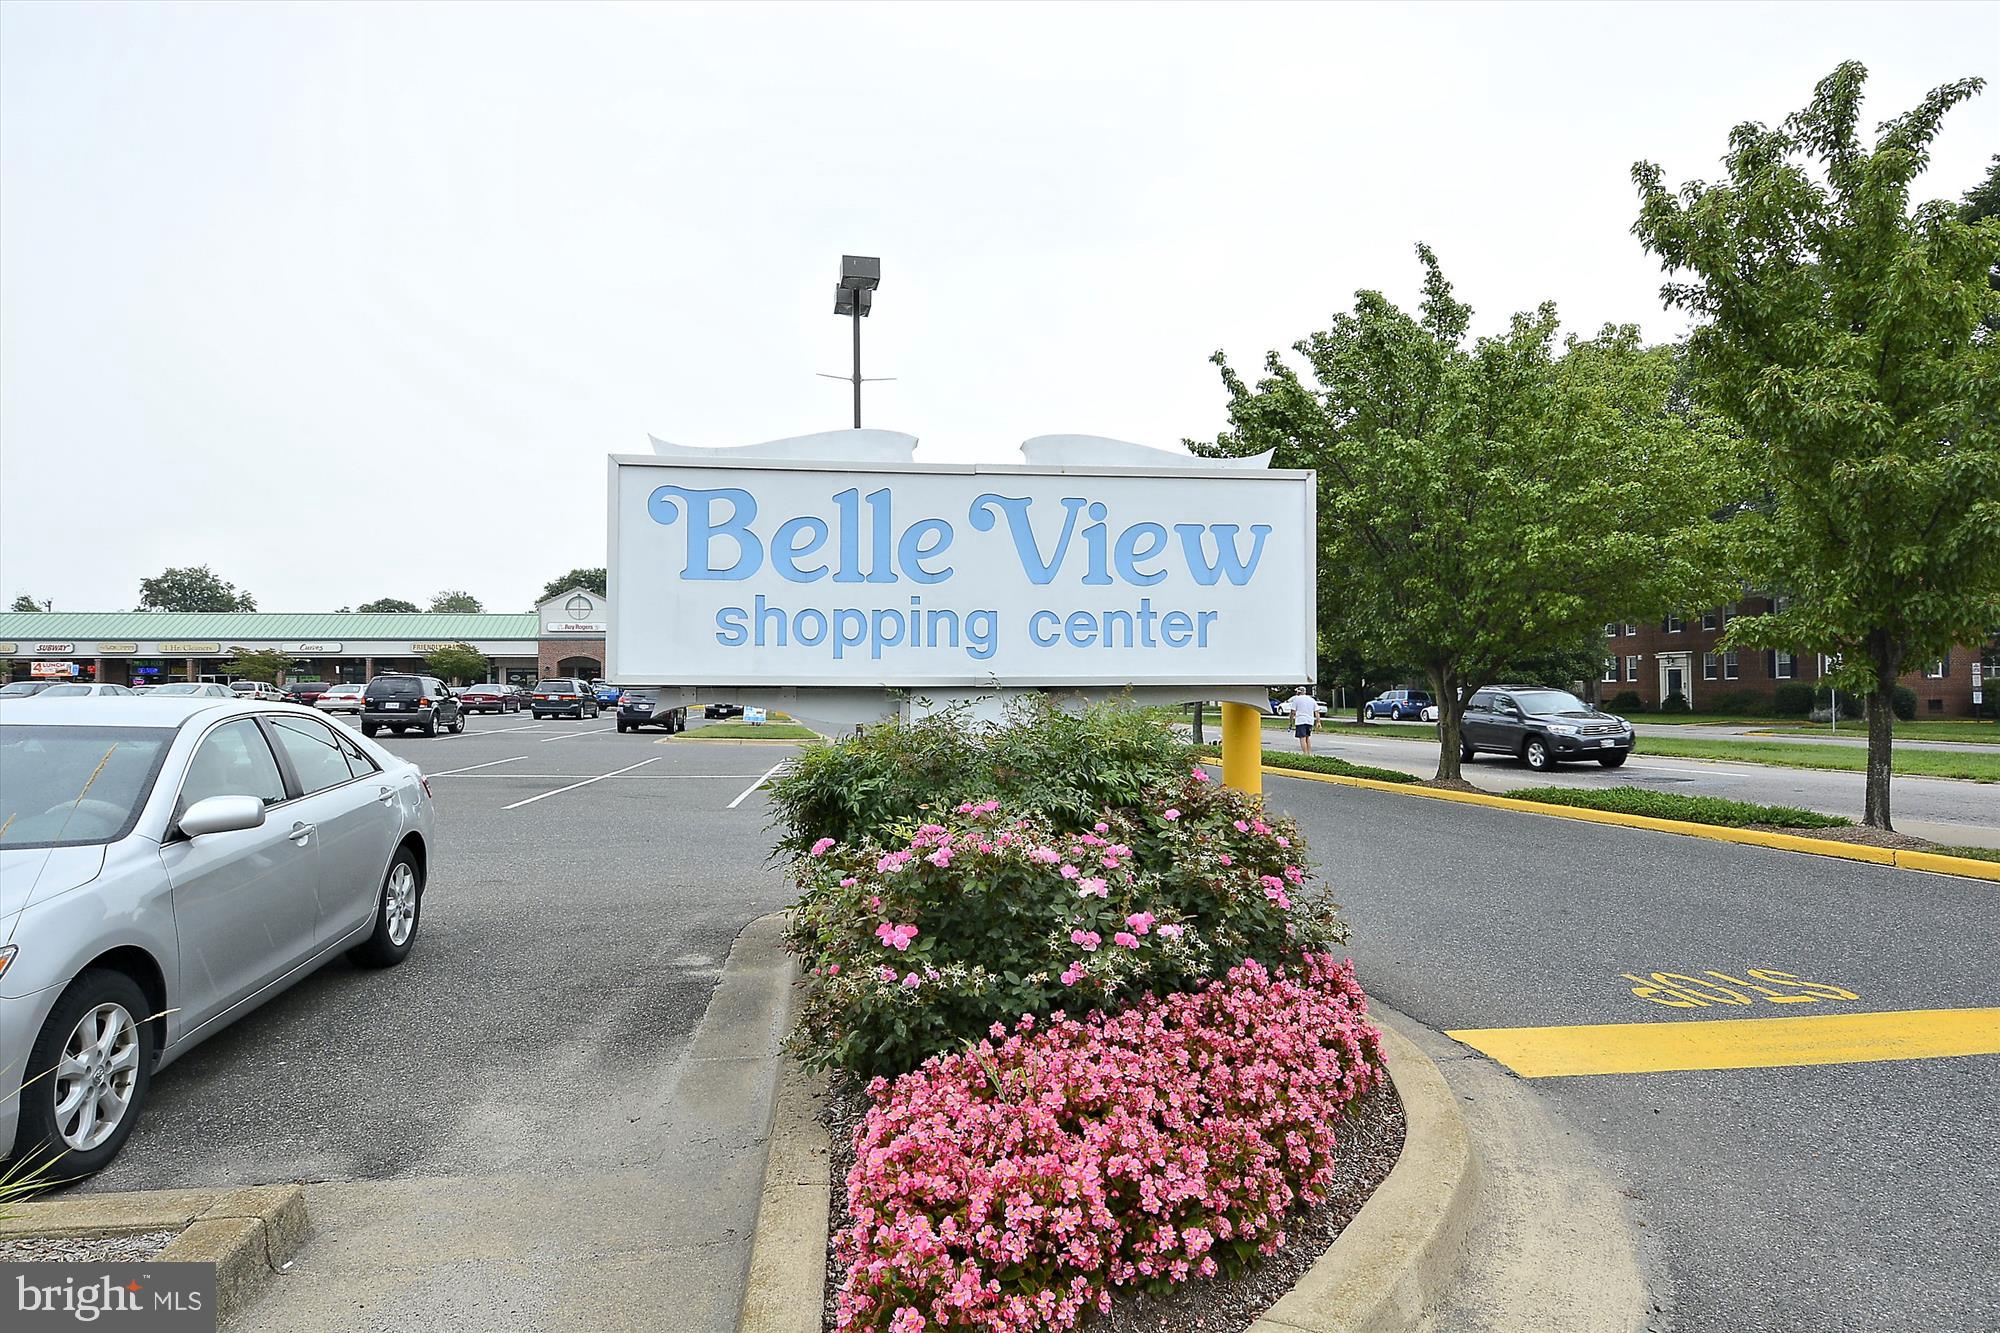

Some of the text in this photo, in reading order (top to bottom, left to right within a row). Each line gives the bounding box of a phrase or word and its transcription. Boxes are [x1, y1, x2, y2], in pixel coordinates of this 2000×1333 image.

[648, 485, 1273, 586] Belle View
[715, 594, 1218, 660] shopping center
[36, 644, 70, 652] SUBWAY
[300, 643, 324, 652] Curves
[1619, 968, 1860, 1008] STOP
